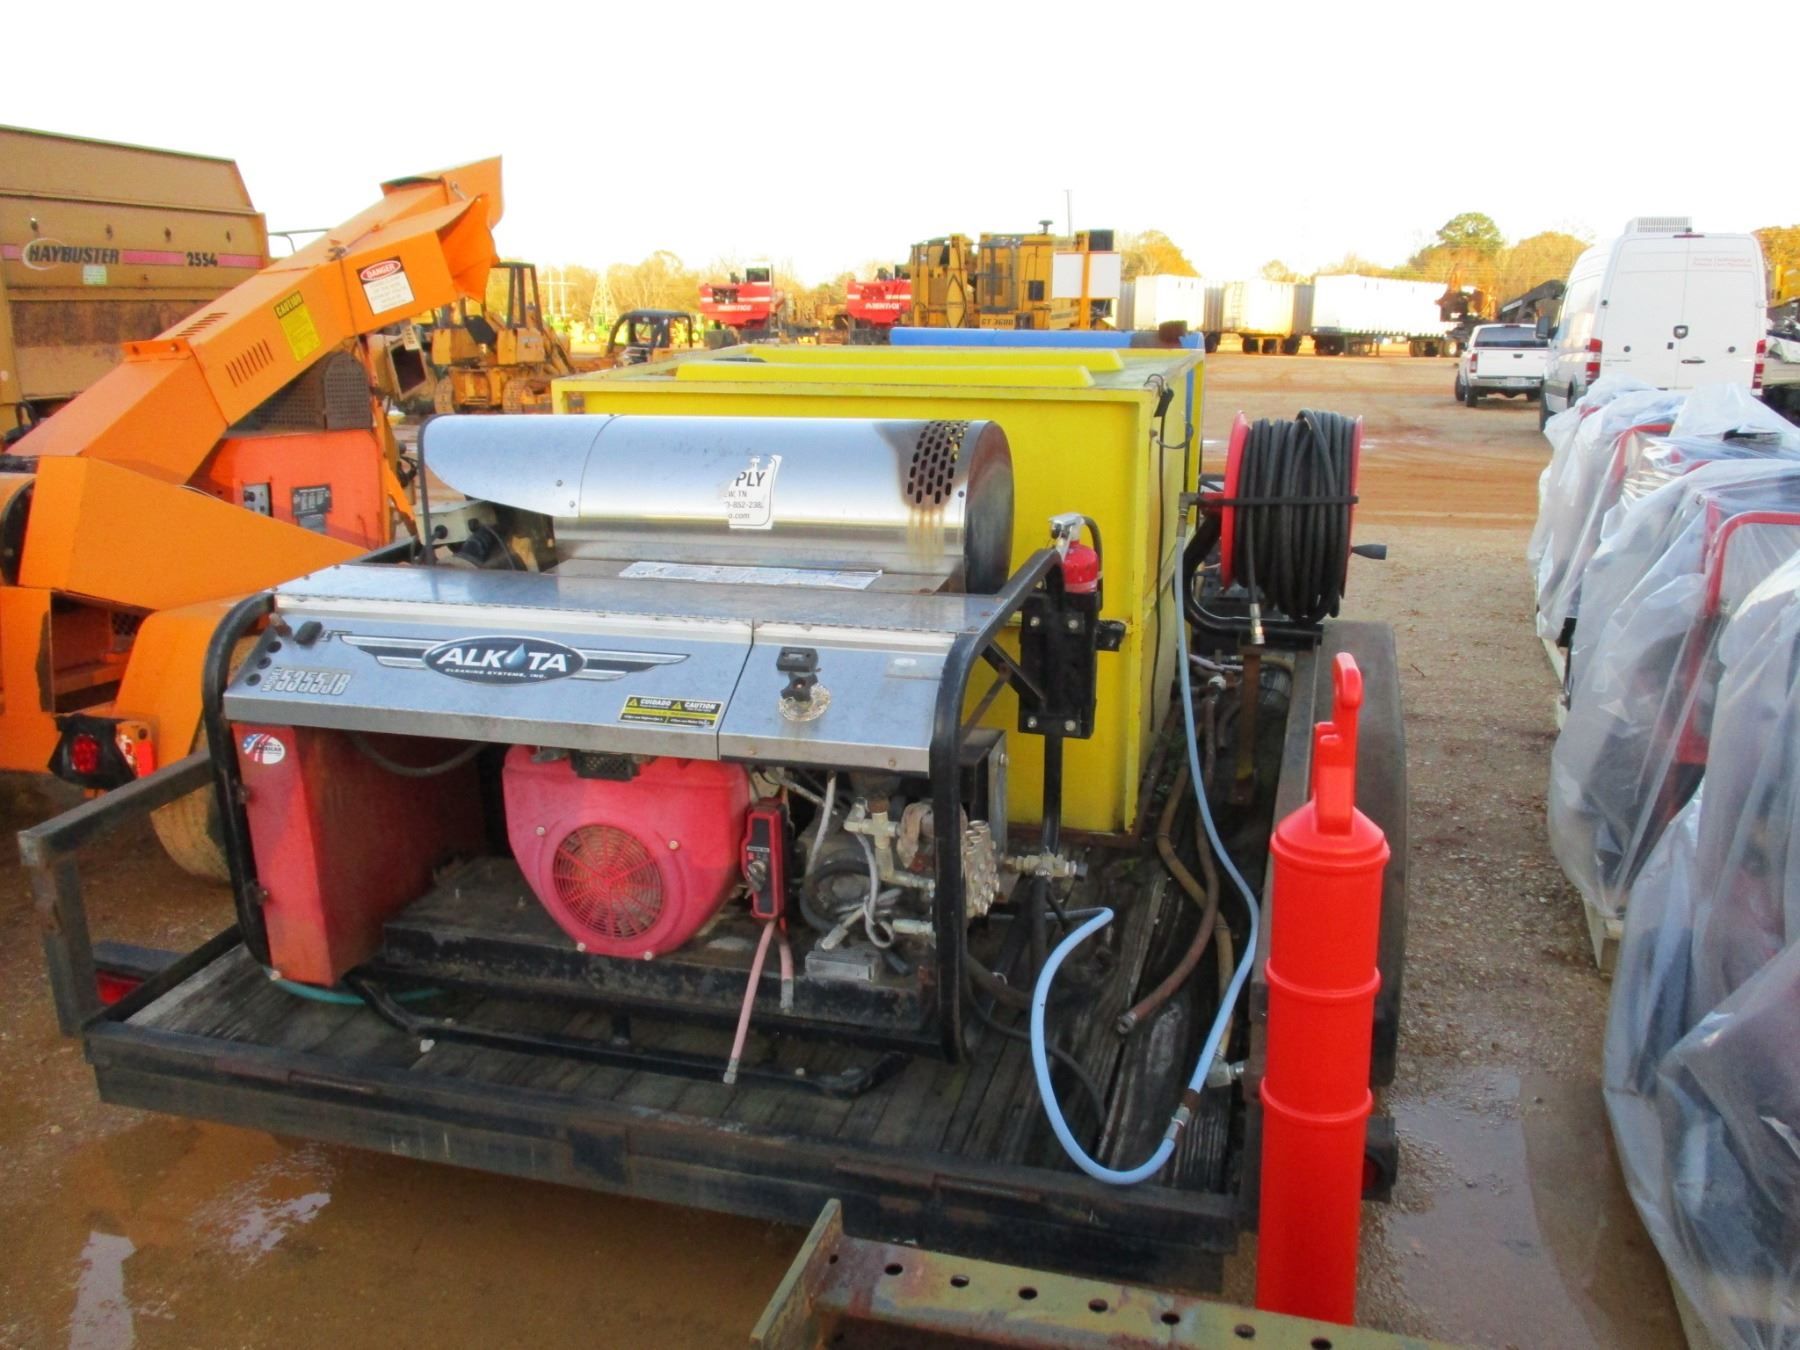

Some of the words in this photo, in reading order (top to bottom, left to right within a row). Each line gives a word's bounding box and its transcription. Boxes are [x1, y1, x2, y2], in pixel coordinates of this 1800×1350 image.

[28, 245, 119, 264] HAYBUSTER
[187, 252, 218, 266] 2554
[366, 263, 396, 278] DANGER
[276, 293, 301, 316] CAUTION
[444, 668, 483, 676] CLEANING
